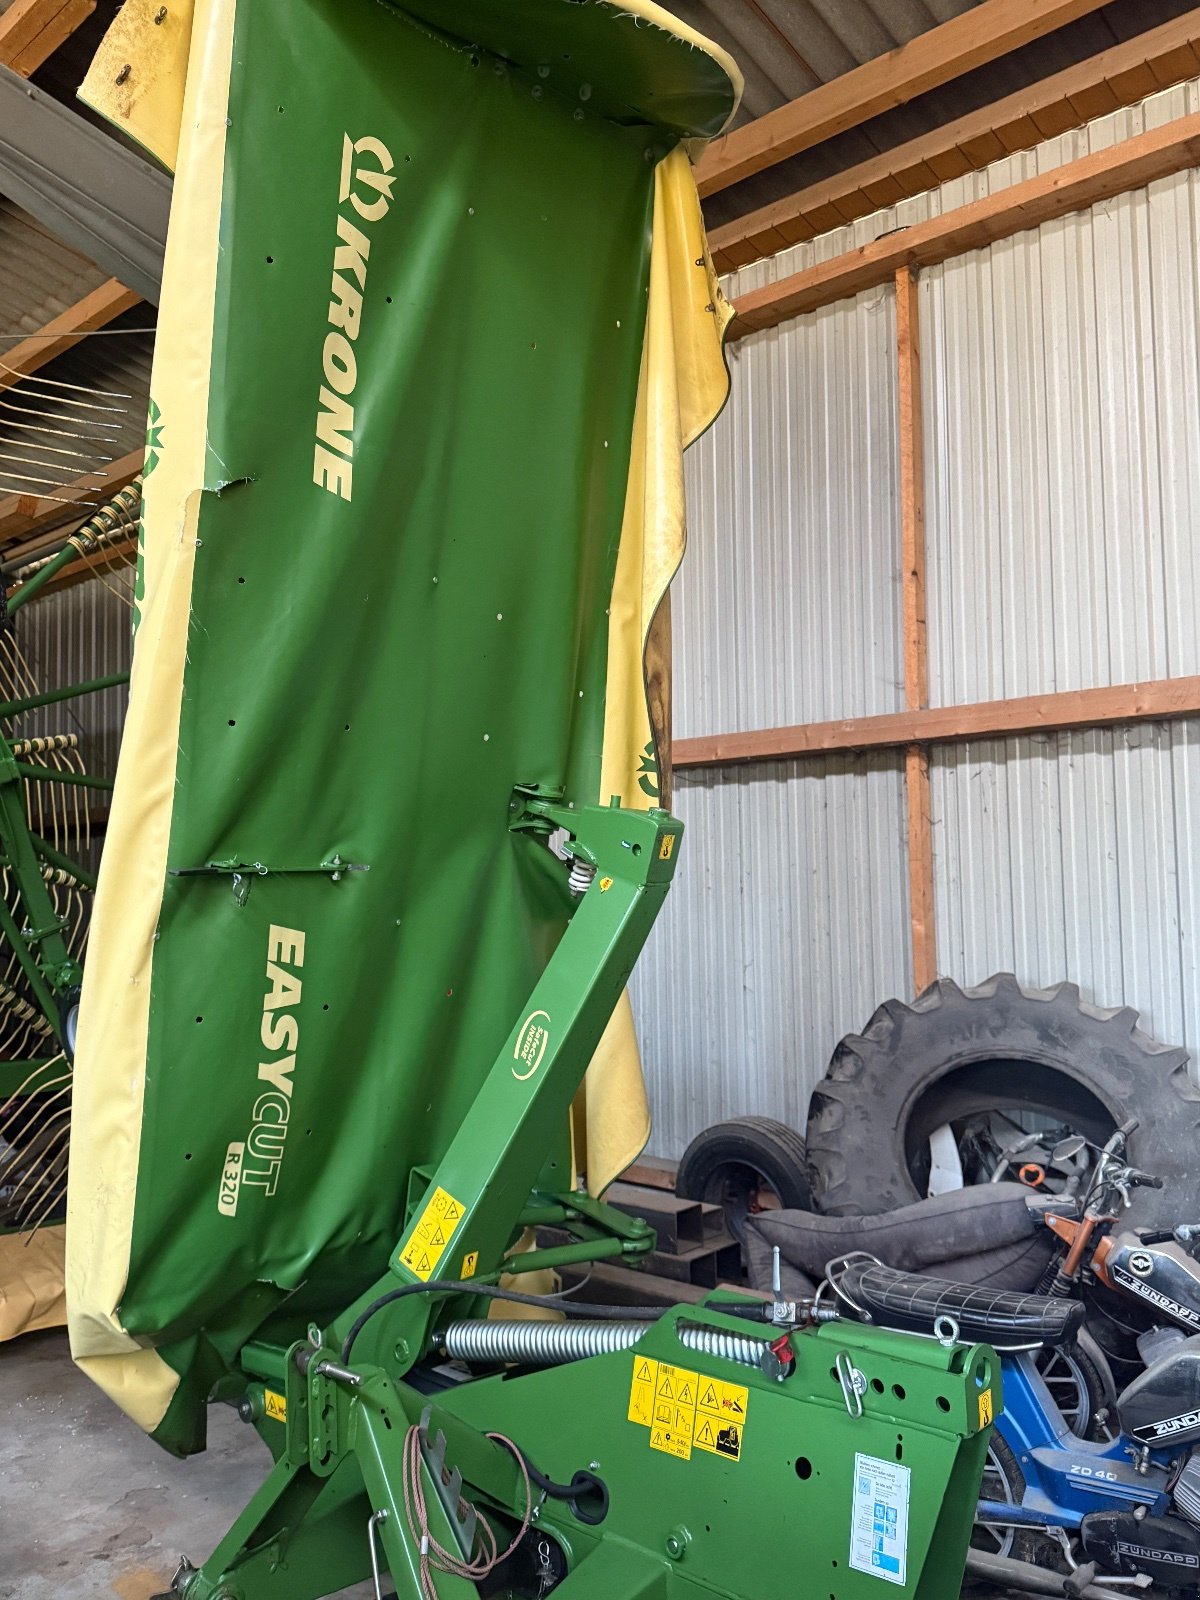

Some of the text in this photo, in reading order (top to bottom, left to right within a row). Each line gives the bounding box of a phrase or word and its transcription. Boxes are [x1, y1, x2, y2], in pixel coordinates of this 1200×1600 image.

[312, 214, 371, 503] KRONE
[242, 924, 306, 1197] EASYCUT
[521, 1024, 537, 1060] INSIDE
[526, 1025, 544, 1067] SafeCut
[221, 1152, 240, 1206] R 320
[1130, 1279, 1200, 1321] ZÜNDAPP
[1070, 1464, 1118, 1481] ZD 40
[1119, 1543, 1196, 1565] ZÜNDAPP
